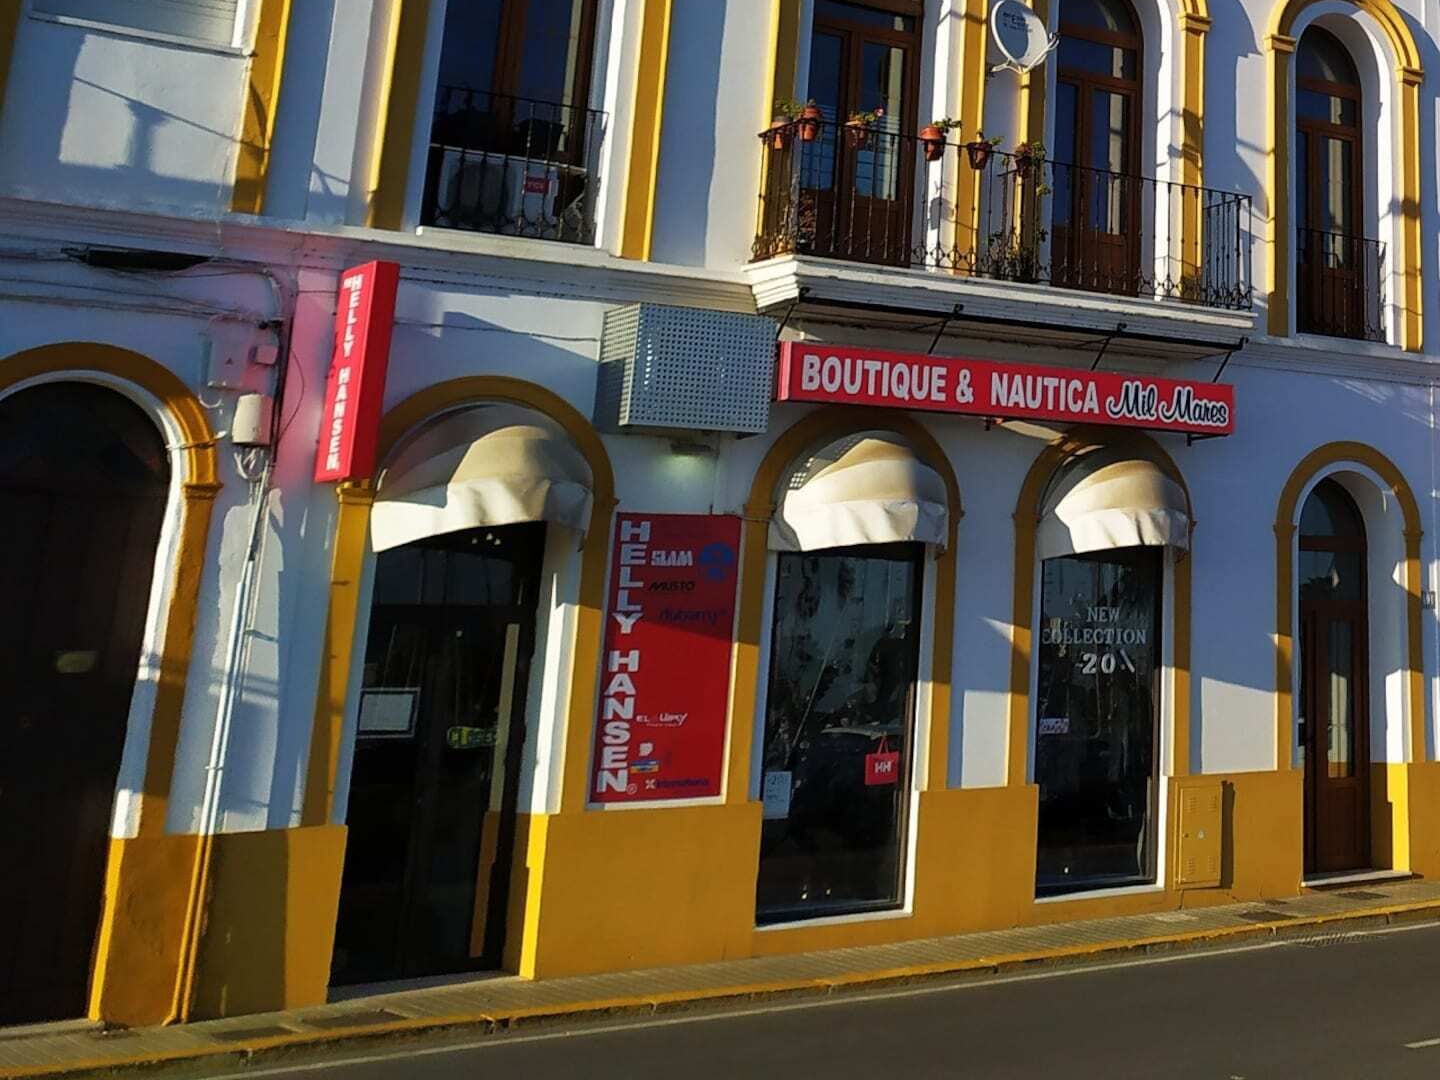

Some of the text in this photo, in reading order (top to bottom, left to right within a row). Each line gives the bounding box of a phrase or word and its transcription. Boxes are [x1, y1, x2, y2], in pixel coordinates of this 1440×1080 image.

[326, 274, 364, 471] HELLY HANSEN
[801, 354, 1229, 428] BOUTIQUE & NAUTICA Mil Mares
[649, 580, 695, 591] MUSTO
[1042, 628, 1147, 644] COLLECTION
[1087, 606, 1121, 622] NEW
[596, 520, 651, 793] HELLY HANSEN
